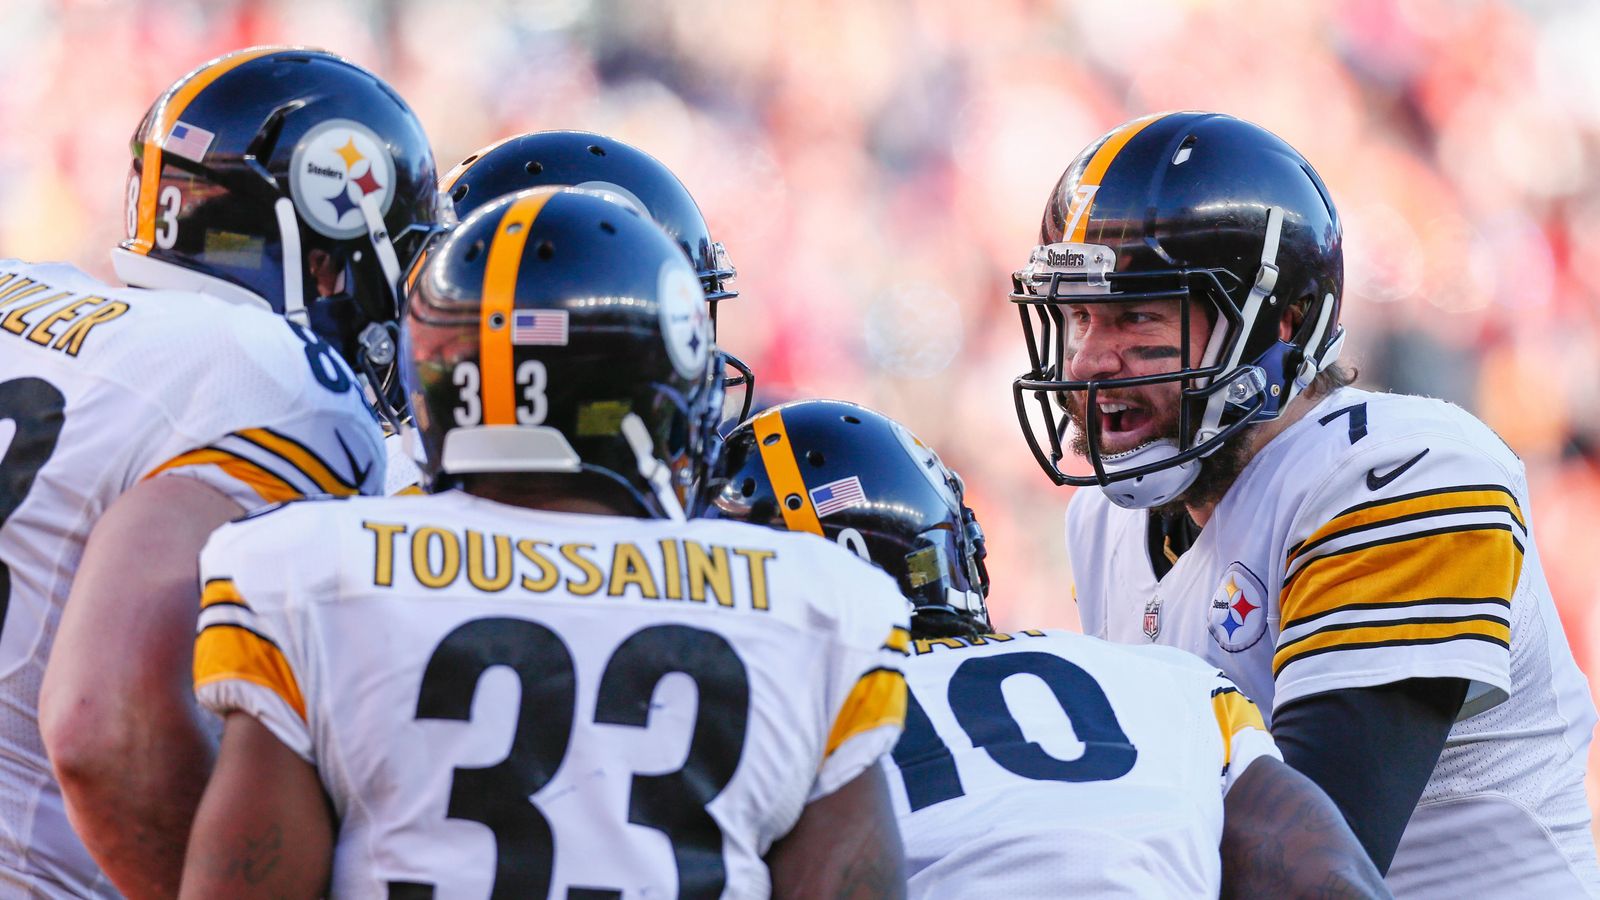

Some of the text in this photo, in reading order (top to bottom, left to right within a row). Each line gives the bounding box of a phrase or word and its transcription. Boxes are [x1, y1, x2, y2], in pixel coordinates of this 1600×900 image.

[307, 162, 343, 180] Steelers
[1063, 184, 1101, 242] 7
[1046, 248, 1085, 266] Steelers
[1318, 401, 1368, 445] 7
[363, 520, 776, 611] TOUSSAINT
[1143, 614, 1158, 633] NFL
[387, 616, 750, 900] 33
